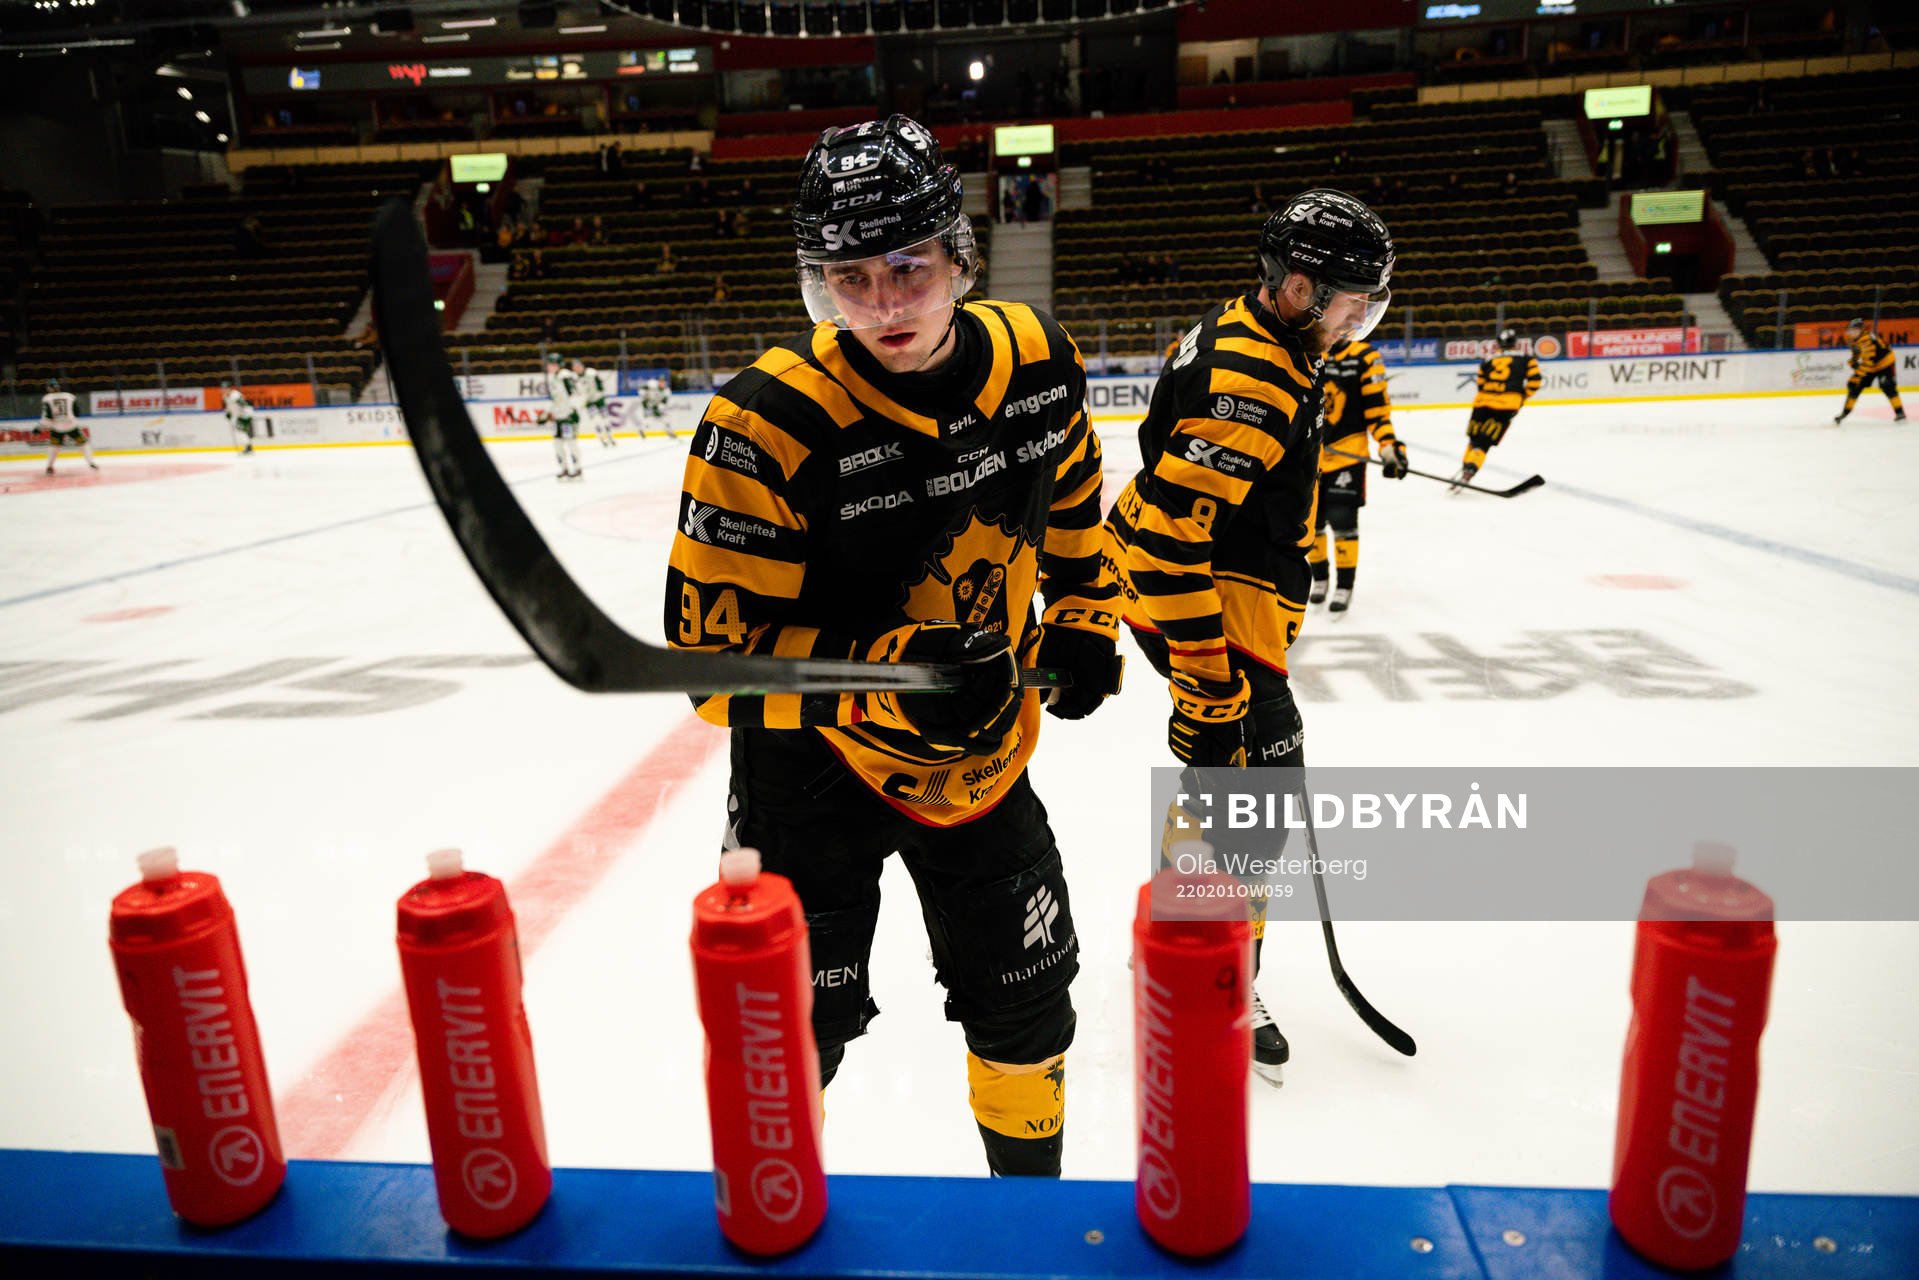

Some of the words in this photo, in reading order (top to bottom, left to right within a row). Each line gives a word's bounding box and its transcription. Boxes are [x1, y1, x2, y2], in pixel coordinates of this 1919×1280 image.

[841, 152, 868, 170] 94
[832, 191, 883, 210] CCM
[859, 213, 901, 230] Skellefteå
[1318, 218, 1336, 229] Kraft
[861, 228, 883, 240] Kraft
[1291, 250, 1324, 265] CCM
[1487, 356, 1512, 381] 3
[1005, 384, 1068, 418] engcon
[1238, 401, 1268, 416] Boliden
[1236, 410, 1263, 424] Electro
[957, 447, 990, 463] CCM
[1217, 461, 1236, 472] Kraft
[840, 490, 914, 520] ŠKODA
[719, 516, 777, 539] Skellefteå
[716, 529, 746, 545] Kraft
[679, 581, 748, 645] 94
[173, 965, 250, 1119] ENERVIT
[437, 978, 504, 1139] ENERVIT
[736, 982, 793, 1151] ENERVIT
[1670, 974, 1736, 1166] ENERVIT
